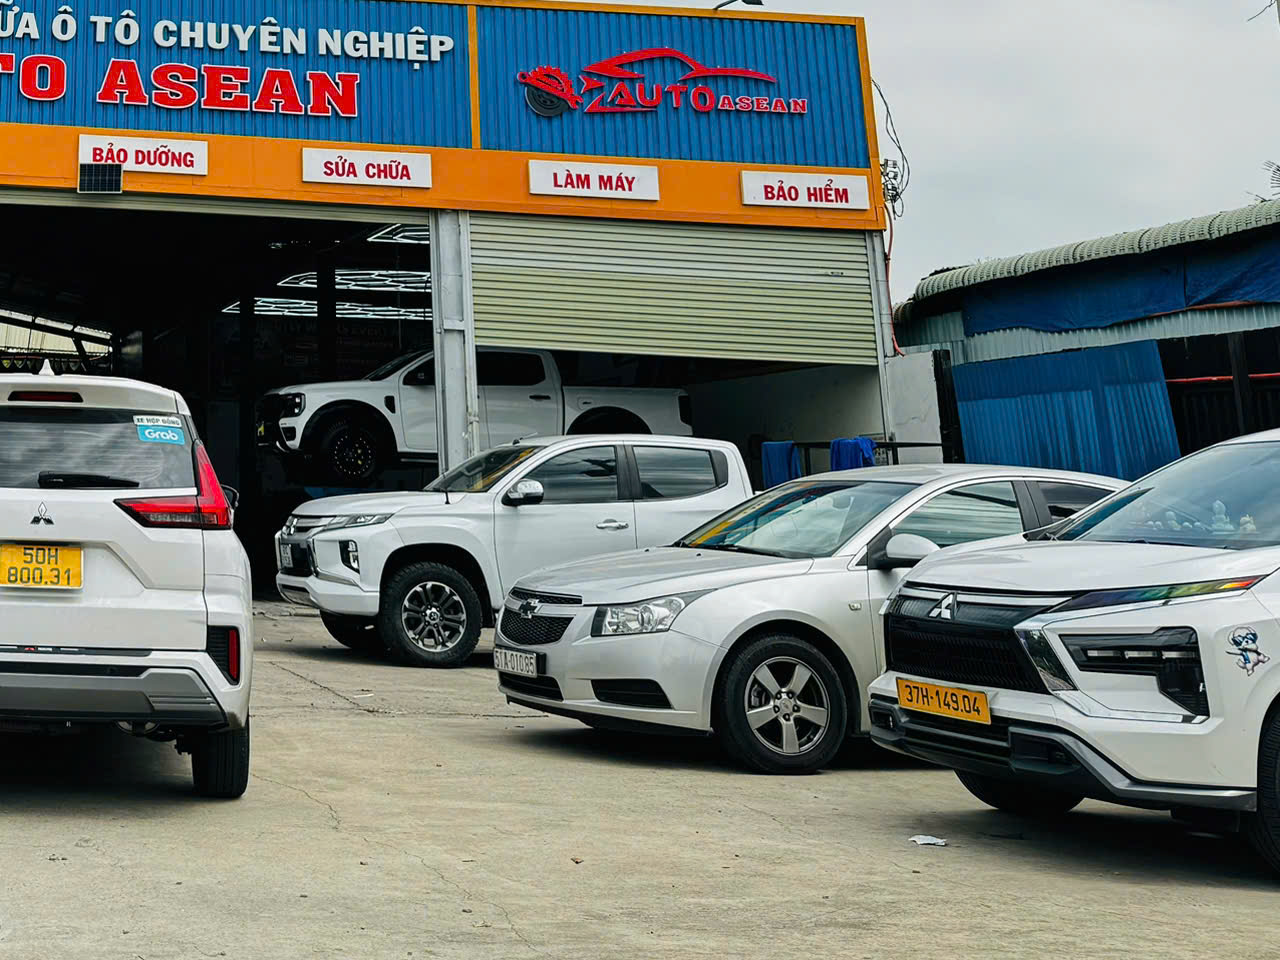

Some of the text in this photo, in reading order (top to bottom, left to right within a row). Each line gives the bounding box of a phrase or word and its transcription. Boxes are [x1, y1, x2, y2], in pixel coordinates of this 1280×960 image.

[51, 3, 77, 42] Ô
[89, 8, 141, 47] TÔ
[153, 16, 307, 56] CHUYÊN
[318, 25, 455, 71] NGHIỆP
[96, 56, 360, 117] ASEAN
[607, 81, 809, 115] AUTO ASEAN
[92, 142, 195, 169] BẢO DƯỠNG
[323, 151, 412, 181] SỬA CHỮA
[552, 170, 637, 193] LÀM MÁY
[763, 178, 850, 204] BẢO HIỂM
[144, 428, 179, 440] Grab
[22, 546, 59, 566] 50H
[7, 566, 72, 586] 800.31
[904, 683, 982, 717] 37H-149.04
